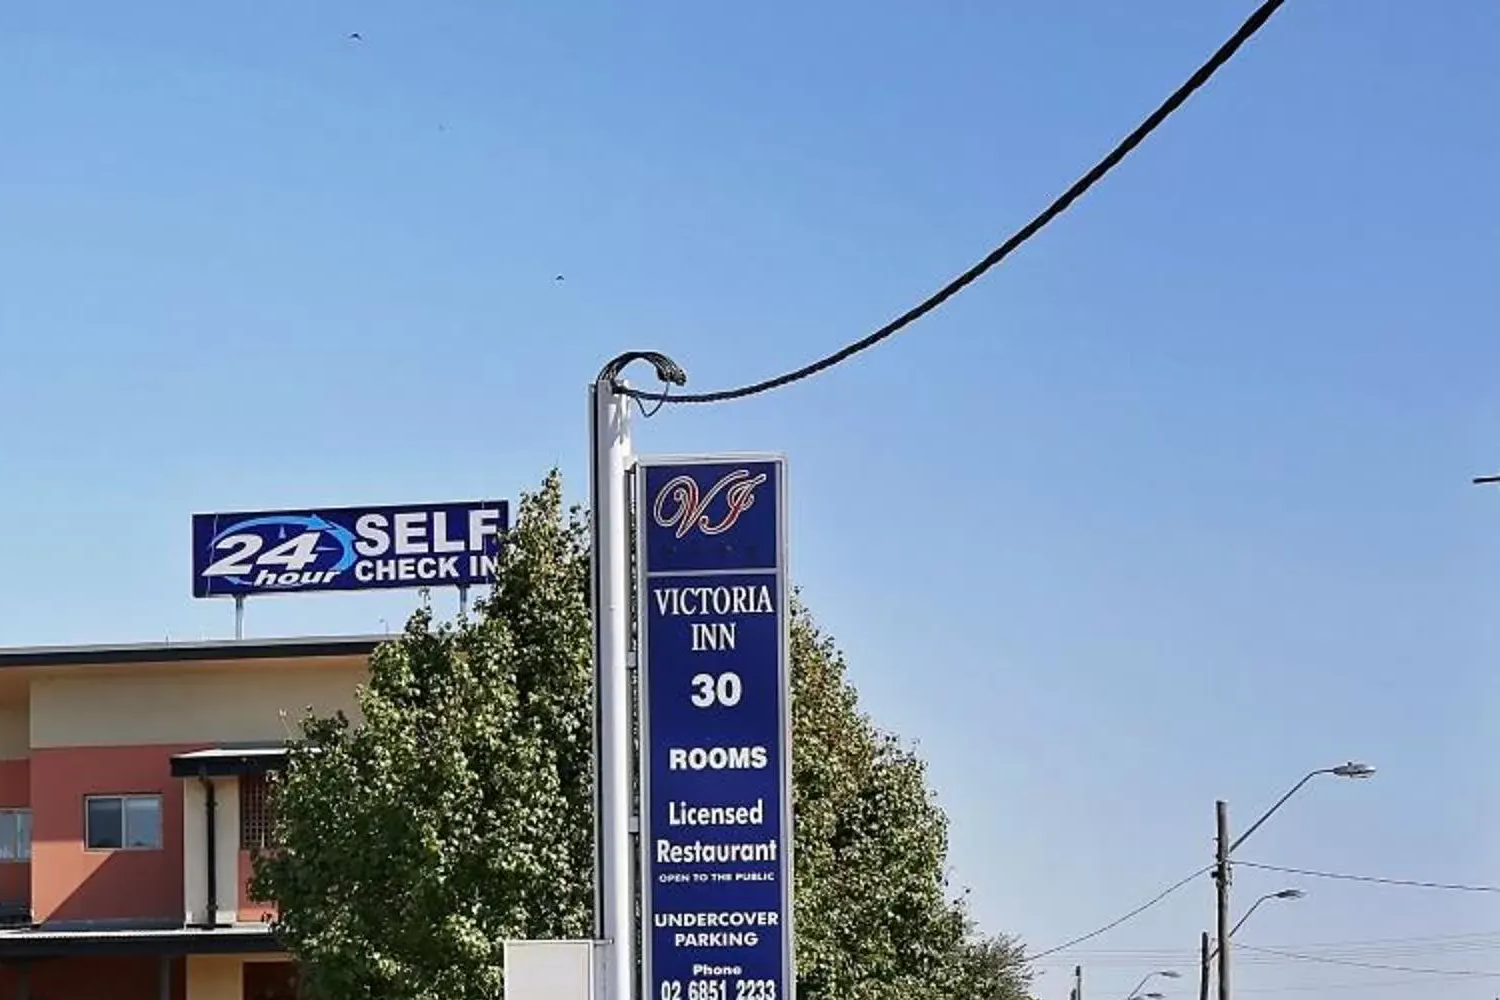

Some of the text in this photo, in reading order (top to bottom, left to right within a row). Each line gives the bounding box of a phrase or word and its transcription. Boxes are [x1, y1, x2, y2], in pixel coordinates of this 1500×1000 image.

[355, 509, 499, 557] SELF
[202, 531, 321, 577] 24
[253, 568, 340, 587] hour
[355, 556, 459, 581] CHECK
[654, 585, 775, 616] VICTORIA
[691, 622, 737, 651] INN
[691, 671, 742, 708] 30
[669, 746, 767, 770] ROOMS
[669, 799, 763, 825] Licensed
[657, 839, 777, 863] Restaurant
[659, 872, 774, 882] OPEN TO THE PUBLIC
[655, 911, 779, 928] UNDERCOVER
[675, 932, 759, 947] PARKING
[693, 964, 742, 976] Phone
